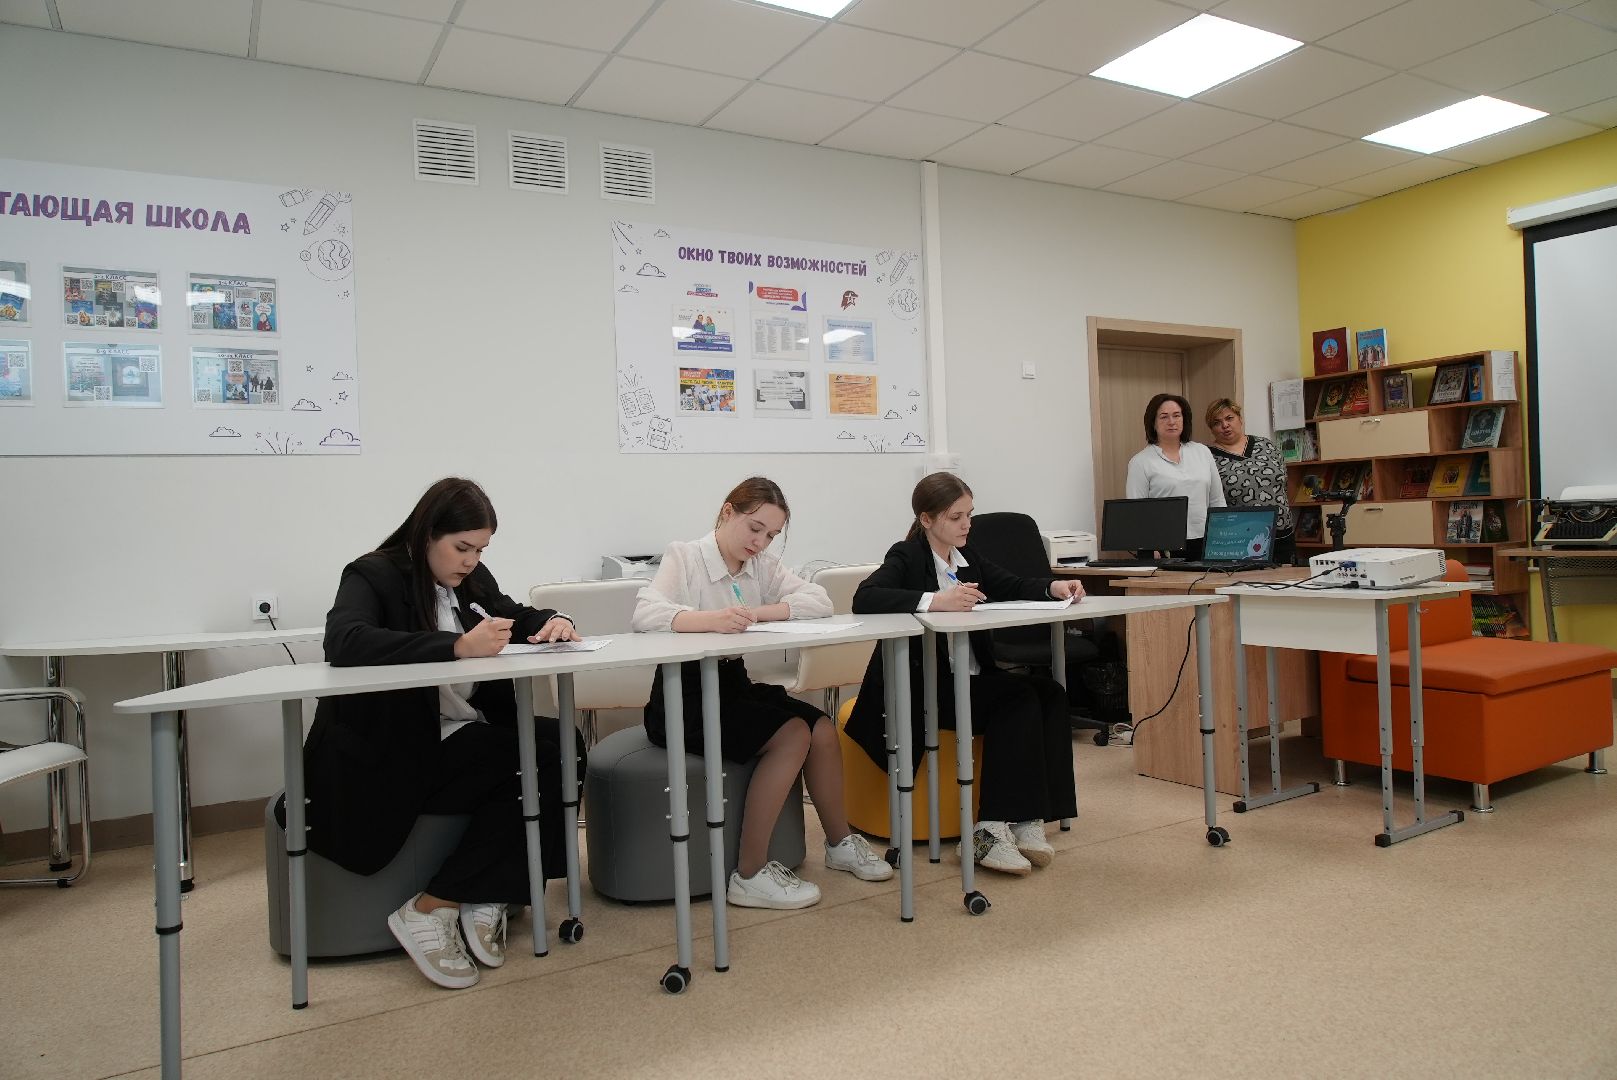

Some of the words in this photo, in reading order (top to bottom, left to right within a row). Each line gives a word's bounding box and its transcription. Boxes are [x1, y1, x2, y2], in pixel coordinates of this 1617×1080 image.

[0, 191, 134, 227] ТАЮЩАЯ
[145, 203, 251, 235] ШКОЛА
[678, 246, 714, 262] ОКНО
[718, 250, 762, 267] ТВОИХ
[767, 255, 867, 277] ВОЗМОЖНОСТЕЙ
